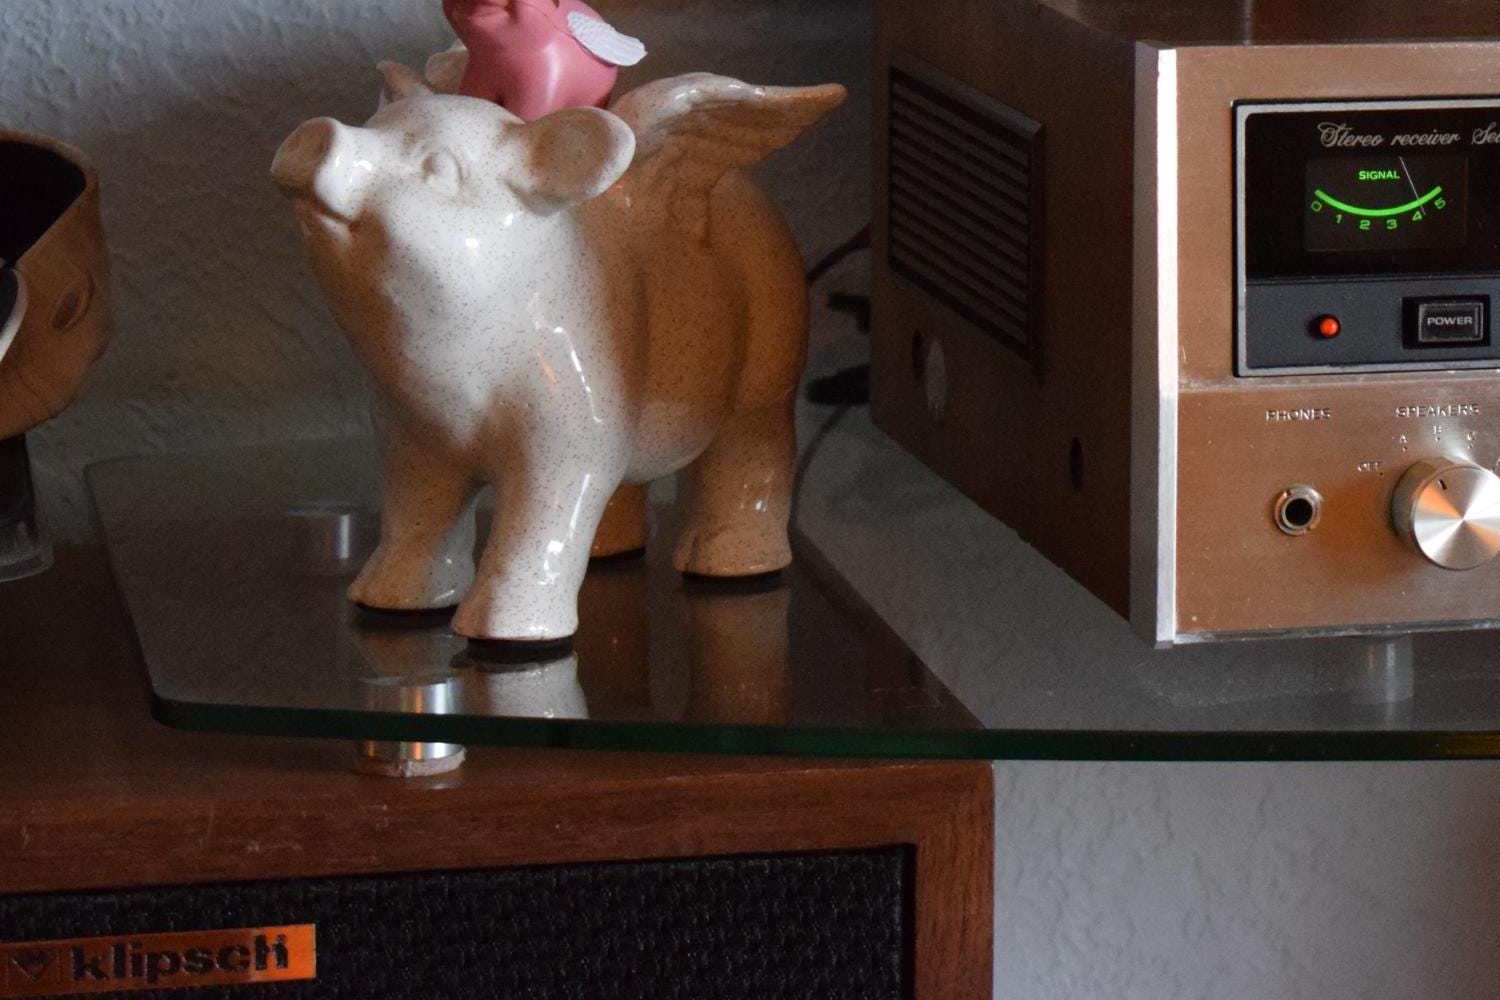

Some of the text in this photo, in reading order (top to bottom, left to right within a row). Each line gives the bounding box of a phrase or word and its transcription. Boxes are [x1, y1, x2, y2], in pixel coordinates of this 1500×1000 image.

[1317, 121, 1384, 148] Stereo
[1390, 128, 1460, 147] receiver
[1359, 170, 1400, 181] SIGNAL
[1311, 198, 1446, 230] 0 1 2 3 4 5
[1427, 316, 1473, 326] POWER
[1265, 408, 1332, 423] PHONES
[1395, 403, 1480, 418] SPEAKERS
[70, 933, 289, 985] klipsch
